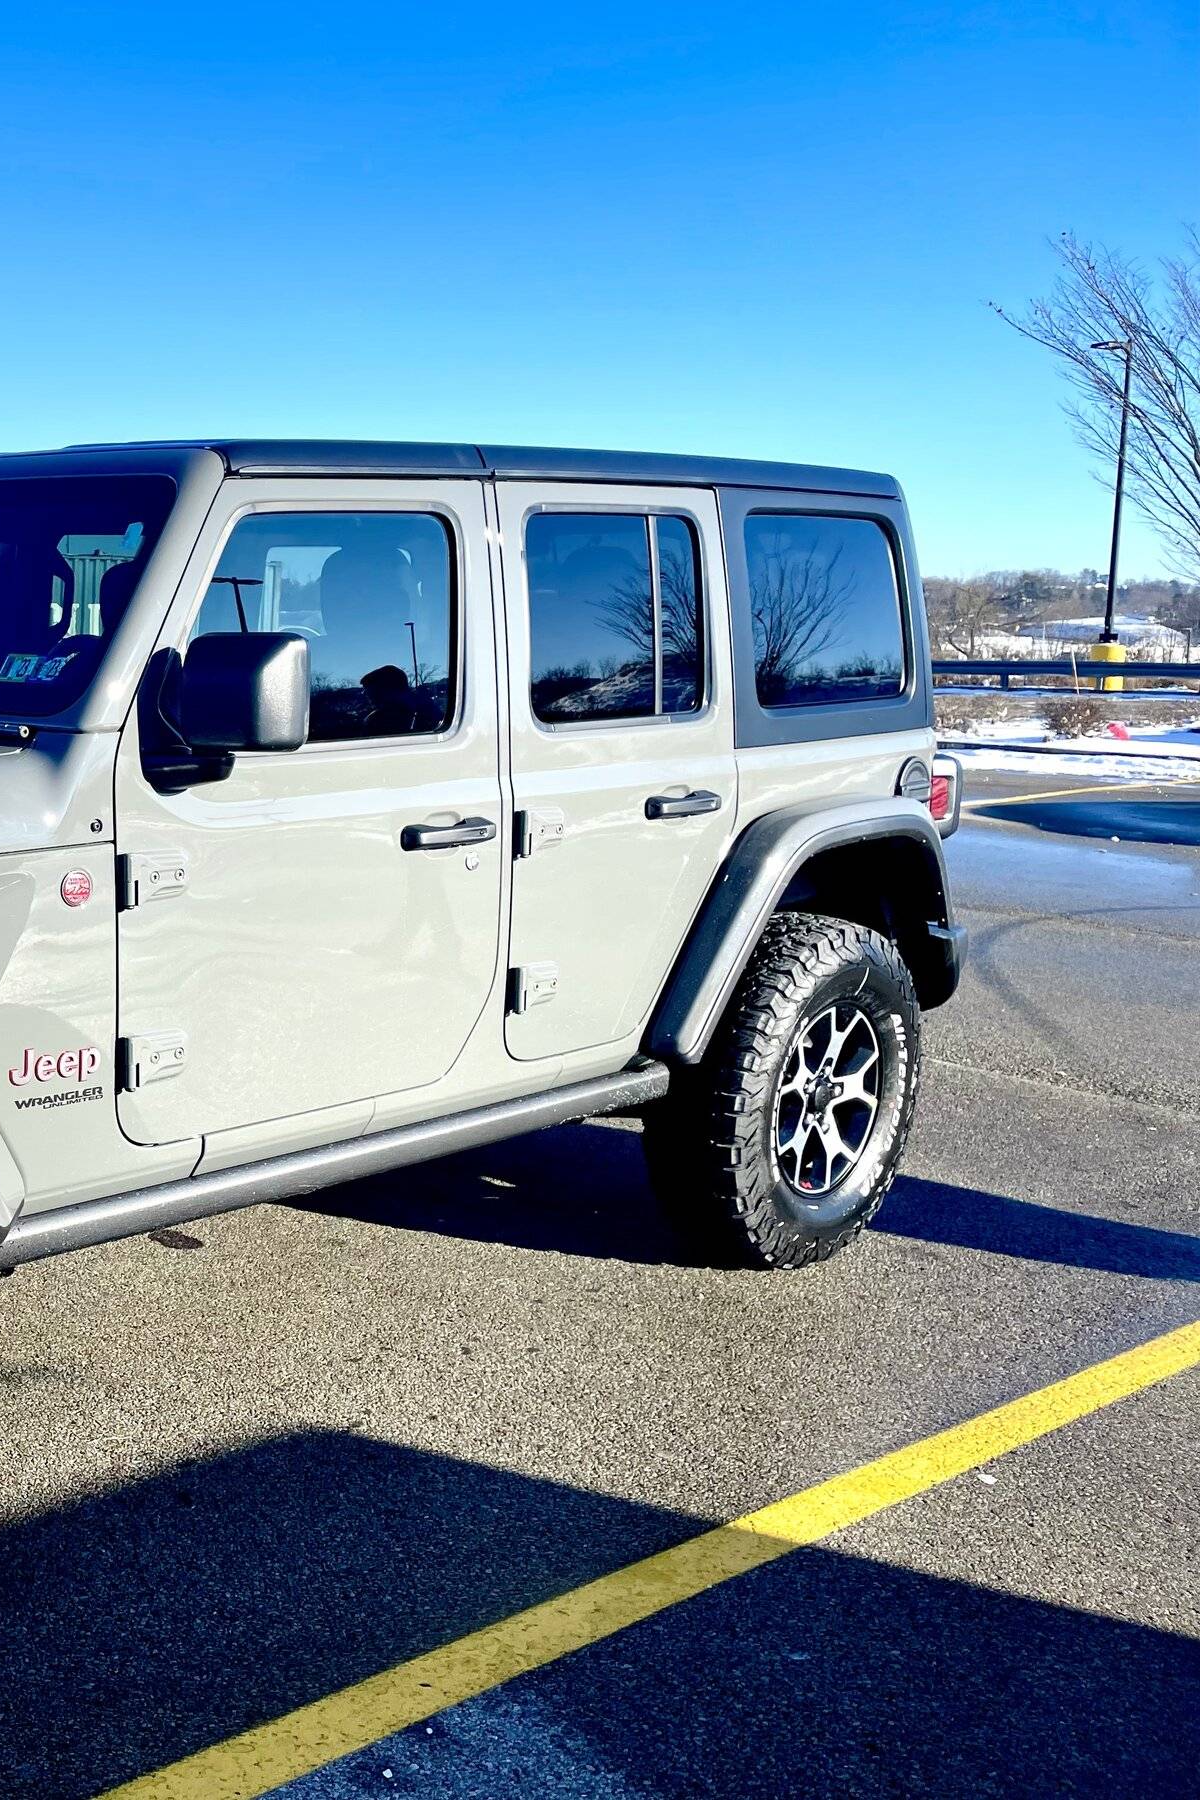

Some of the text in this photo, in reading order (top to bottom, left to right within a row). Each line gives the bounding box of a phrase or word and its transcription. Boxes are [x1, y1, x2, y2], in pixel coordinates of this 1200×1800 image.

[8, 1047, 102, 1087] Jeep
[14, 1086, 104, 1110] WRANGLER
[43, 1094, 104, 1110] UNLIMITED
